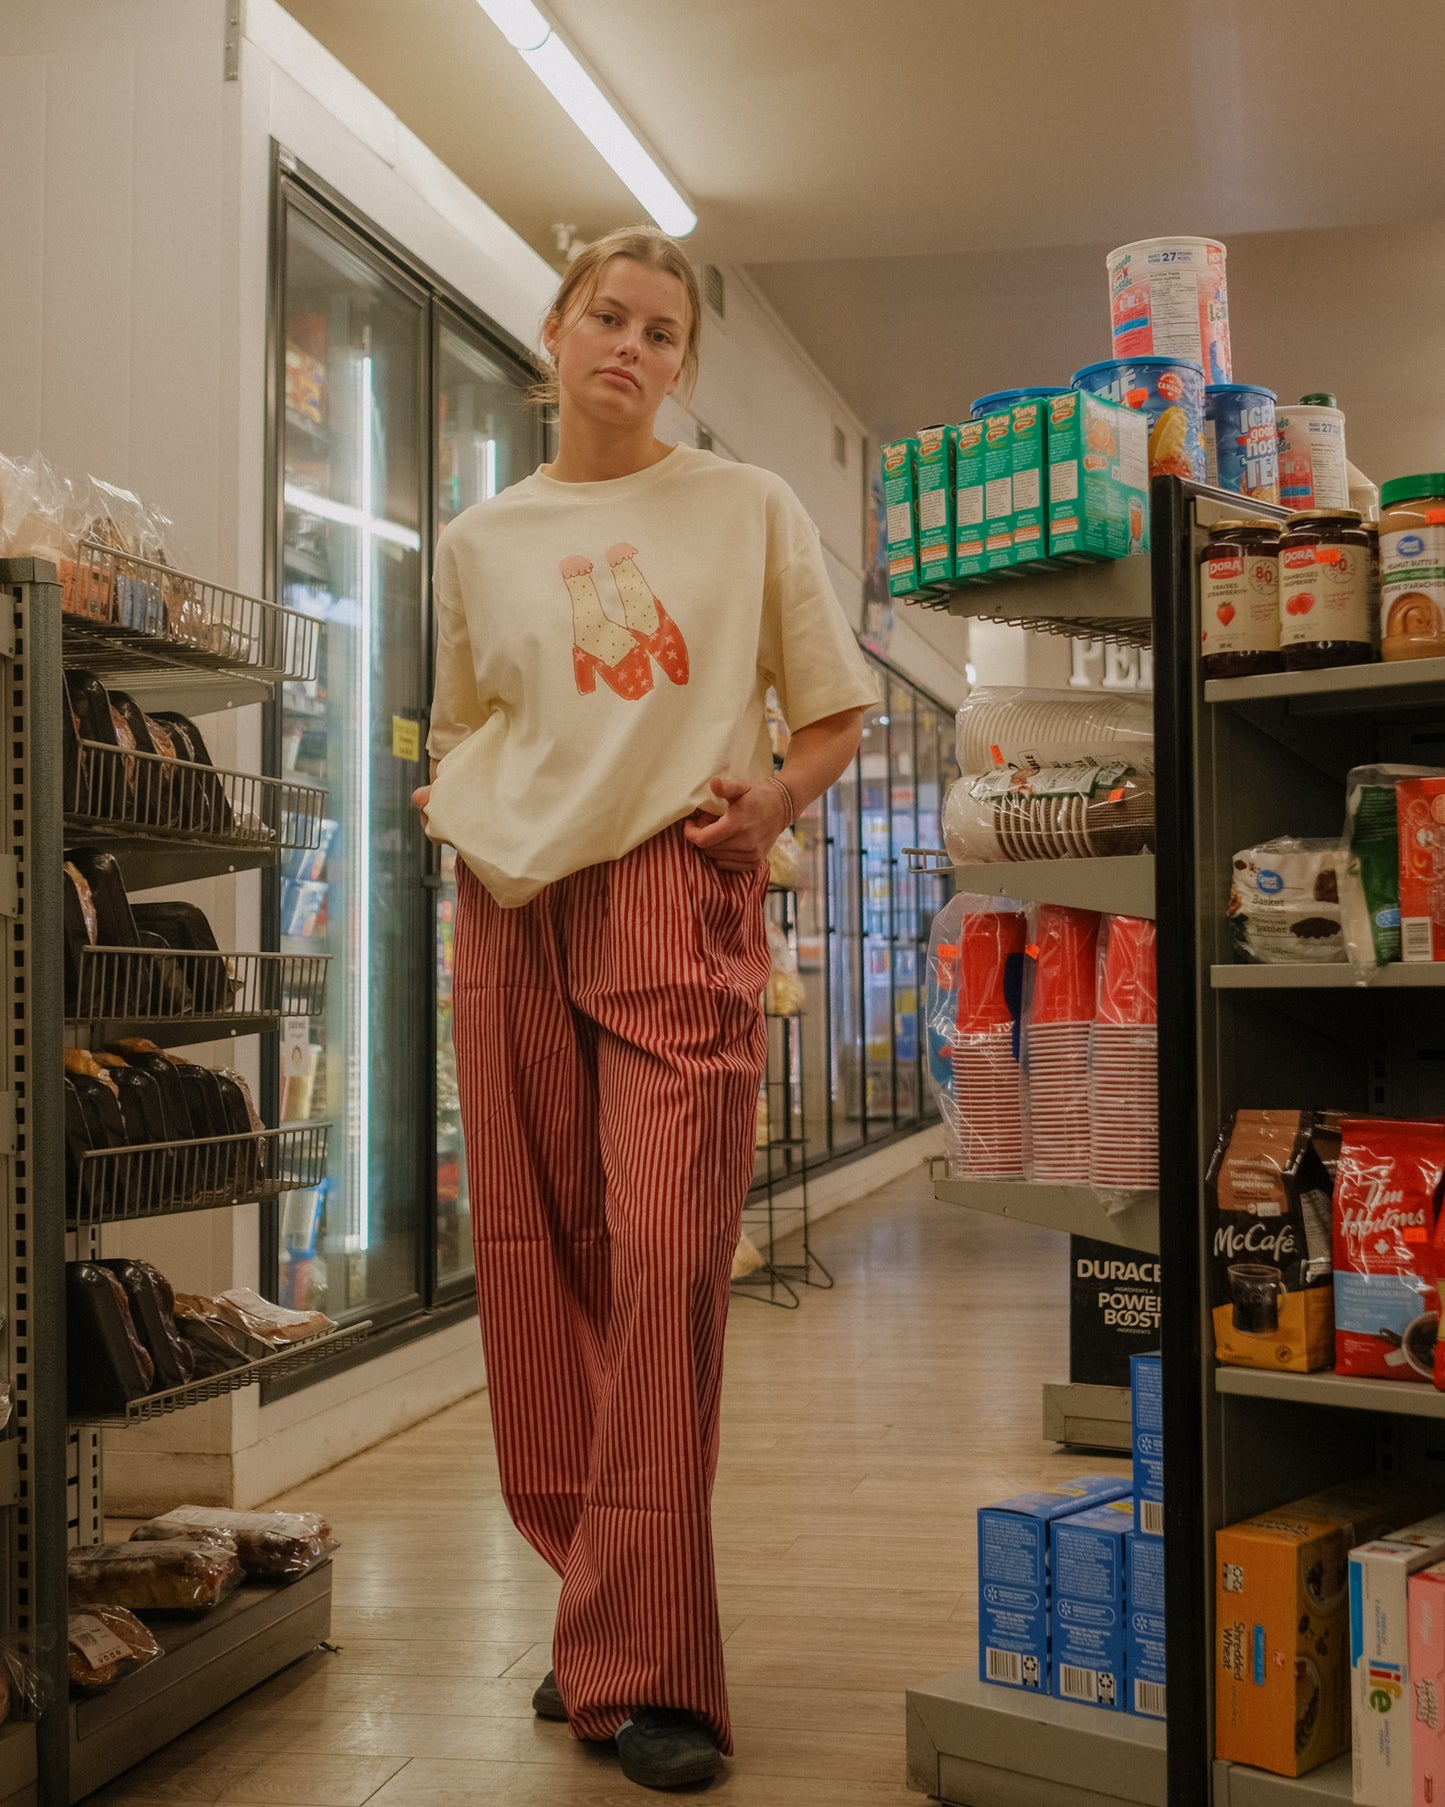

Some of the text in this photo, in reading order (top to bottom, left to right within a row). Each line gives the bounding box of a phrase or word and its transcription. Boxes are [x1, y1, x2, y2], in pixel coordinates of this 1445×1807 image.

[1161, 252, 1177, 262] 27
[1093, 368, 1136, 402] HÉ
[1050, 395, 1076, 411] Tang
[1012, 404, 1037, 418] Tang
[986, 415, 1010, 428] Tang
[1321, 423, 1333, 433] 27
[917, 430, 944, 444] Tang
[958, 424, 983, 436] Tang
[883, 443, 907, 458] Tang
[1284, 549, 1315, 563] DORA
[1210, 560, 1241, 573] DORA
[1255, 566, 1272, 583] 80
[1252, 895, 1285, 906] Basket
[1255, 925, 1288, 934] panier
[1227, 1159, 1260, 1167] Premium
[1360, 1169, 1404, 1208] Tim
[1341, 1208, 1425, 1241] Hortons
[1104, 1309, 1161, 1328] BOOST
[1222, 1628, 1234, 1670] Wheat
[1233, 1620, 1246, 1682] Shredded
[1368, 1659, 1404, 1714] life
[1423, 1677, 1439, 1729] FROSTED
